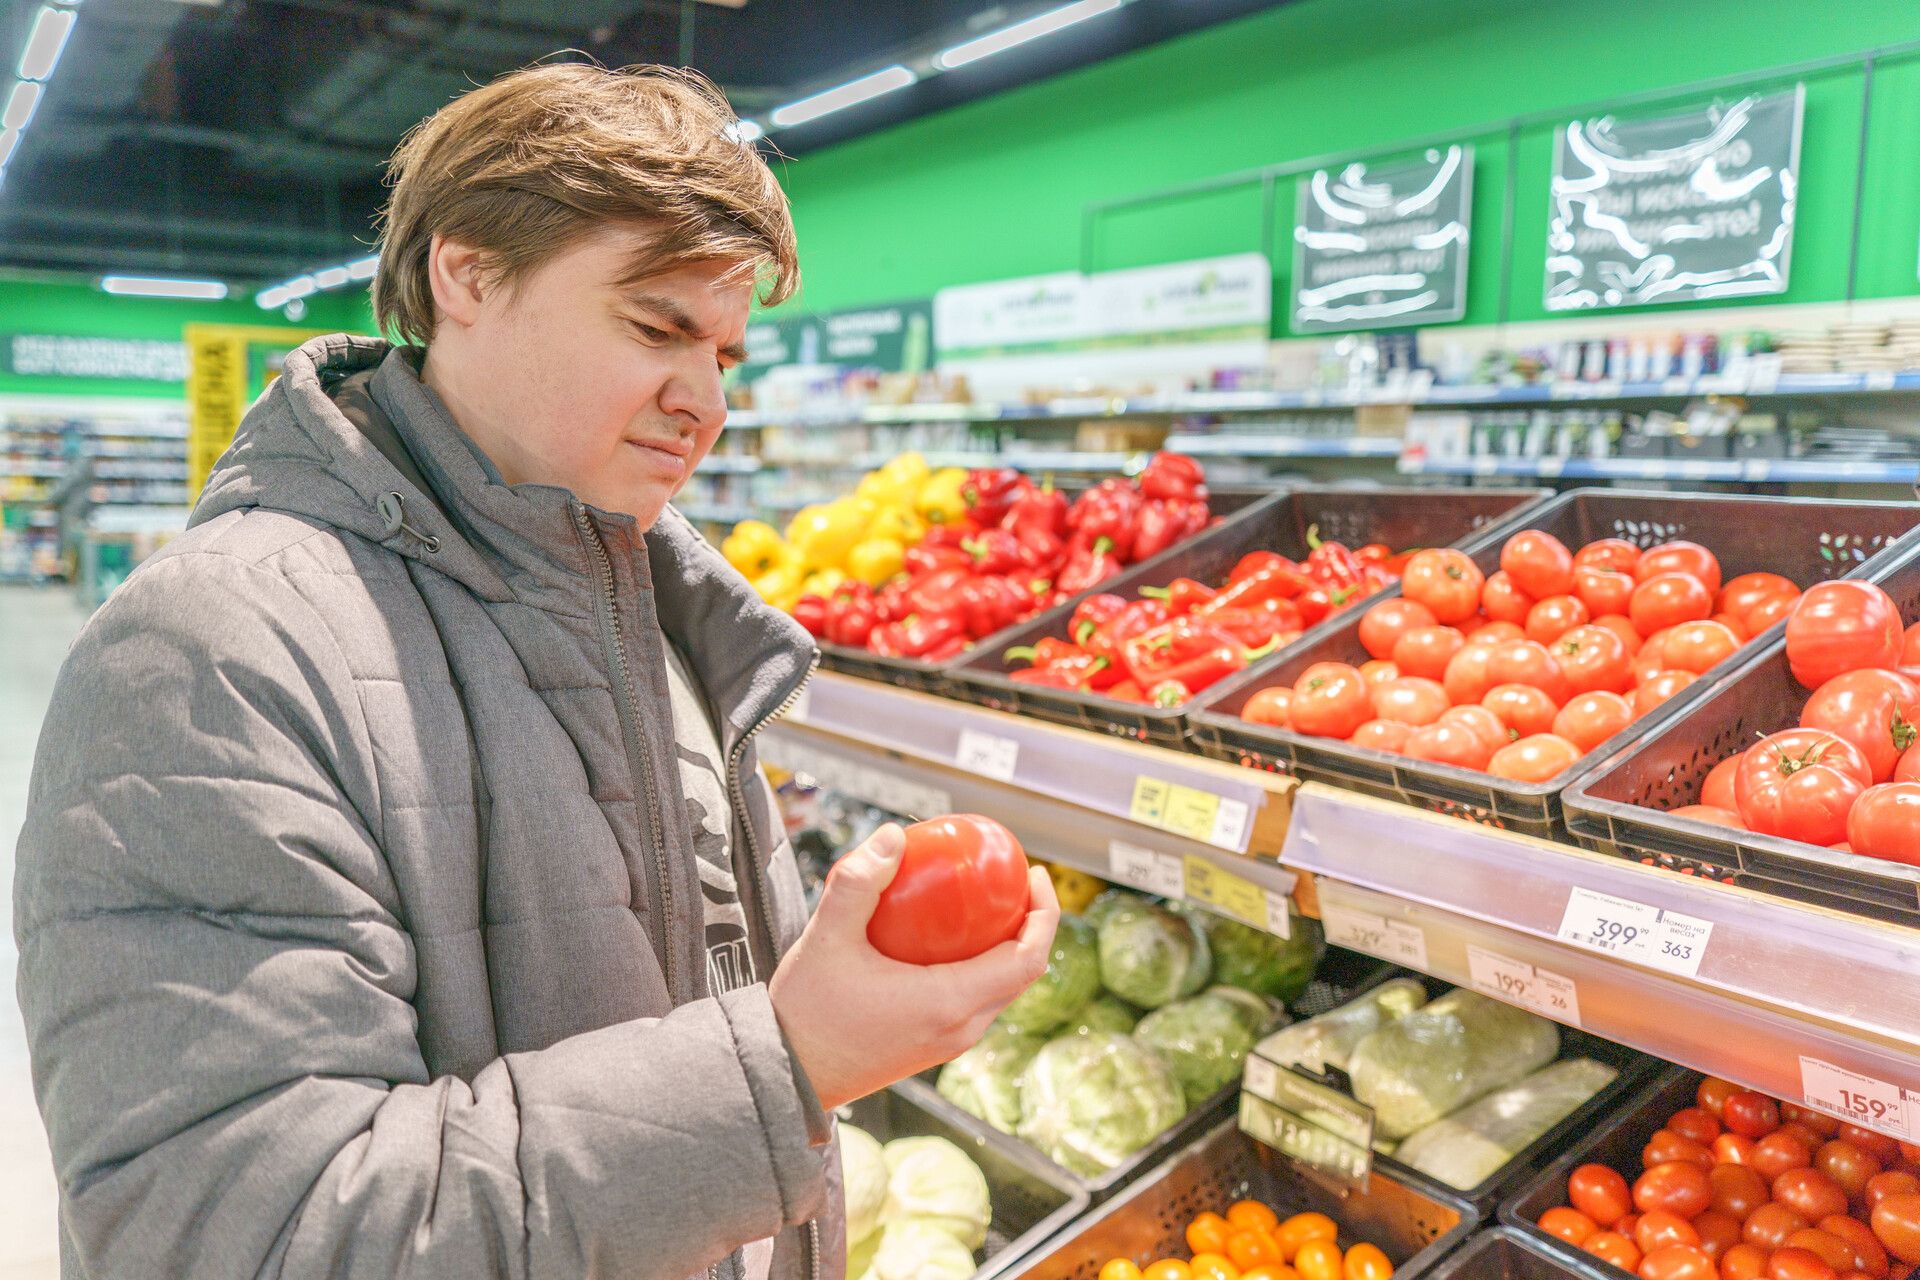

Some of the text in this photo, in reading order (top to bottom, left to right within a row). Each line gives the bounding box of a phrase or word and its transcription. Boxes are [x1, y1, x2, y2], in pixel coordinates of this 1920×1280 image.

[1592, 918, 1638, 945] 399
[1661, 940, 1692, 959] 363
[1493, 971, 1525, 994] 199
[1550, 995, 1567, 1009] 26
[1839, 1089, 1886, 1119] 159
